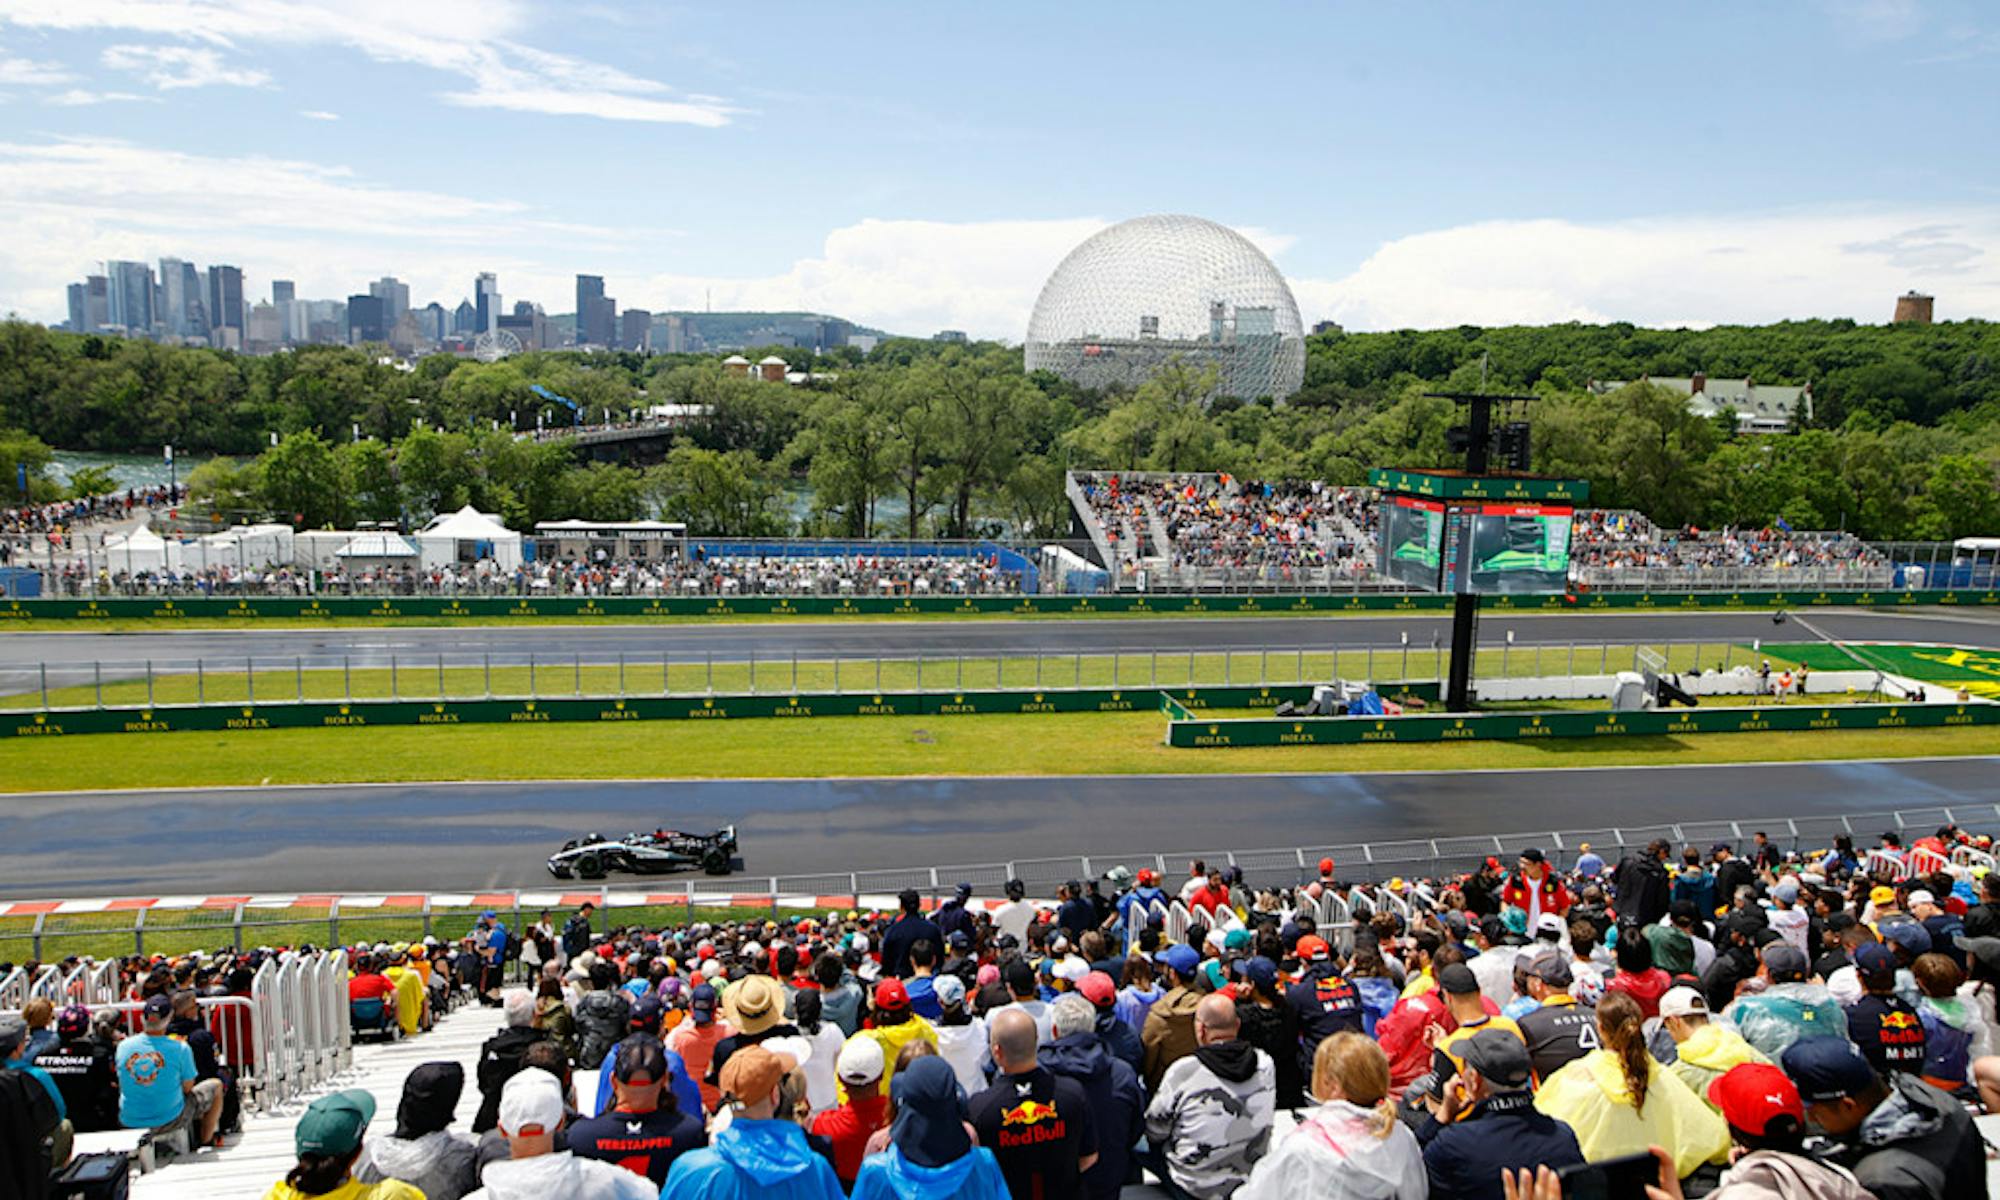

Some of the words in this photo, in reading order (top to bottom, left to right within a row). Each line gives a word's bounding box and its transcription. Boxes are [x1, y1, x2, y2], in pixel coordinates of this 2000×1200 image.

[941, 704, 975, 713] ROLEX
[1023, 703, 1054, 711] ROLEX
[1101, 701, 1131, 709] ROLEX
[690, 709, 726, 717] ROLEX
[776, 707, 810, 715] ROLEX
[859, 705, 894, 714] ROLEX
[420, 714, 458, 723] ROLEX
[511, 712, 549, 721] ROLEX
[601, 711, 638, 719] ROLEX
[1946, 715, 1972, 723] ROLEX
[228, 718, 267, 728] ROLEX
[325, 716, 364, 725] ROLEX
[126, 721, 168, 731] ROLEX
[1596, 725, 1625, 733] ROLEX
[1669, 723, 1697, 731] ROLEX
[1740, 721, 1769, 729] ROLEX
[18, 725, 62, 735] ROLEX
[1443, 729, 1473, 737] ROLEX
[1520, 727, 1551, 735] ROLEX
[1281, 734, 1314, 742] ROLEX
[1363, 731, 1395, 739] ROLEX
[1195, 735, 1230, 744] ROLEX
[1879, 1029, 1905, 1043] Red
[34, 1055, 93, 1066] PETRONAS
[999, 1127, 1032, 1147] Red
[1033, 1120, 1065, 1142] Bull
[596, 1136, 673, 1150] VERSTAPPEN
